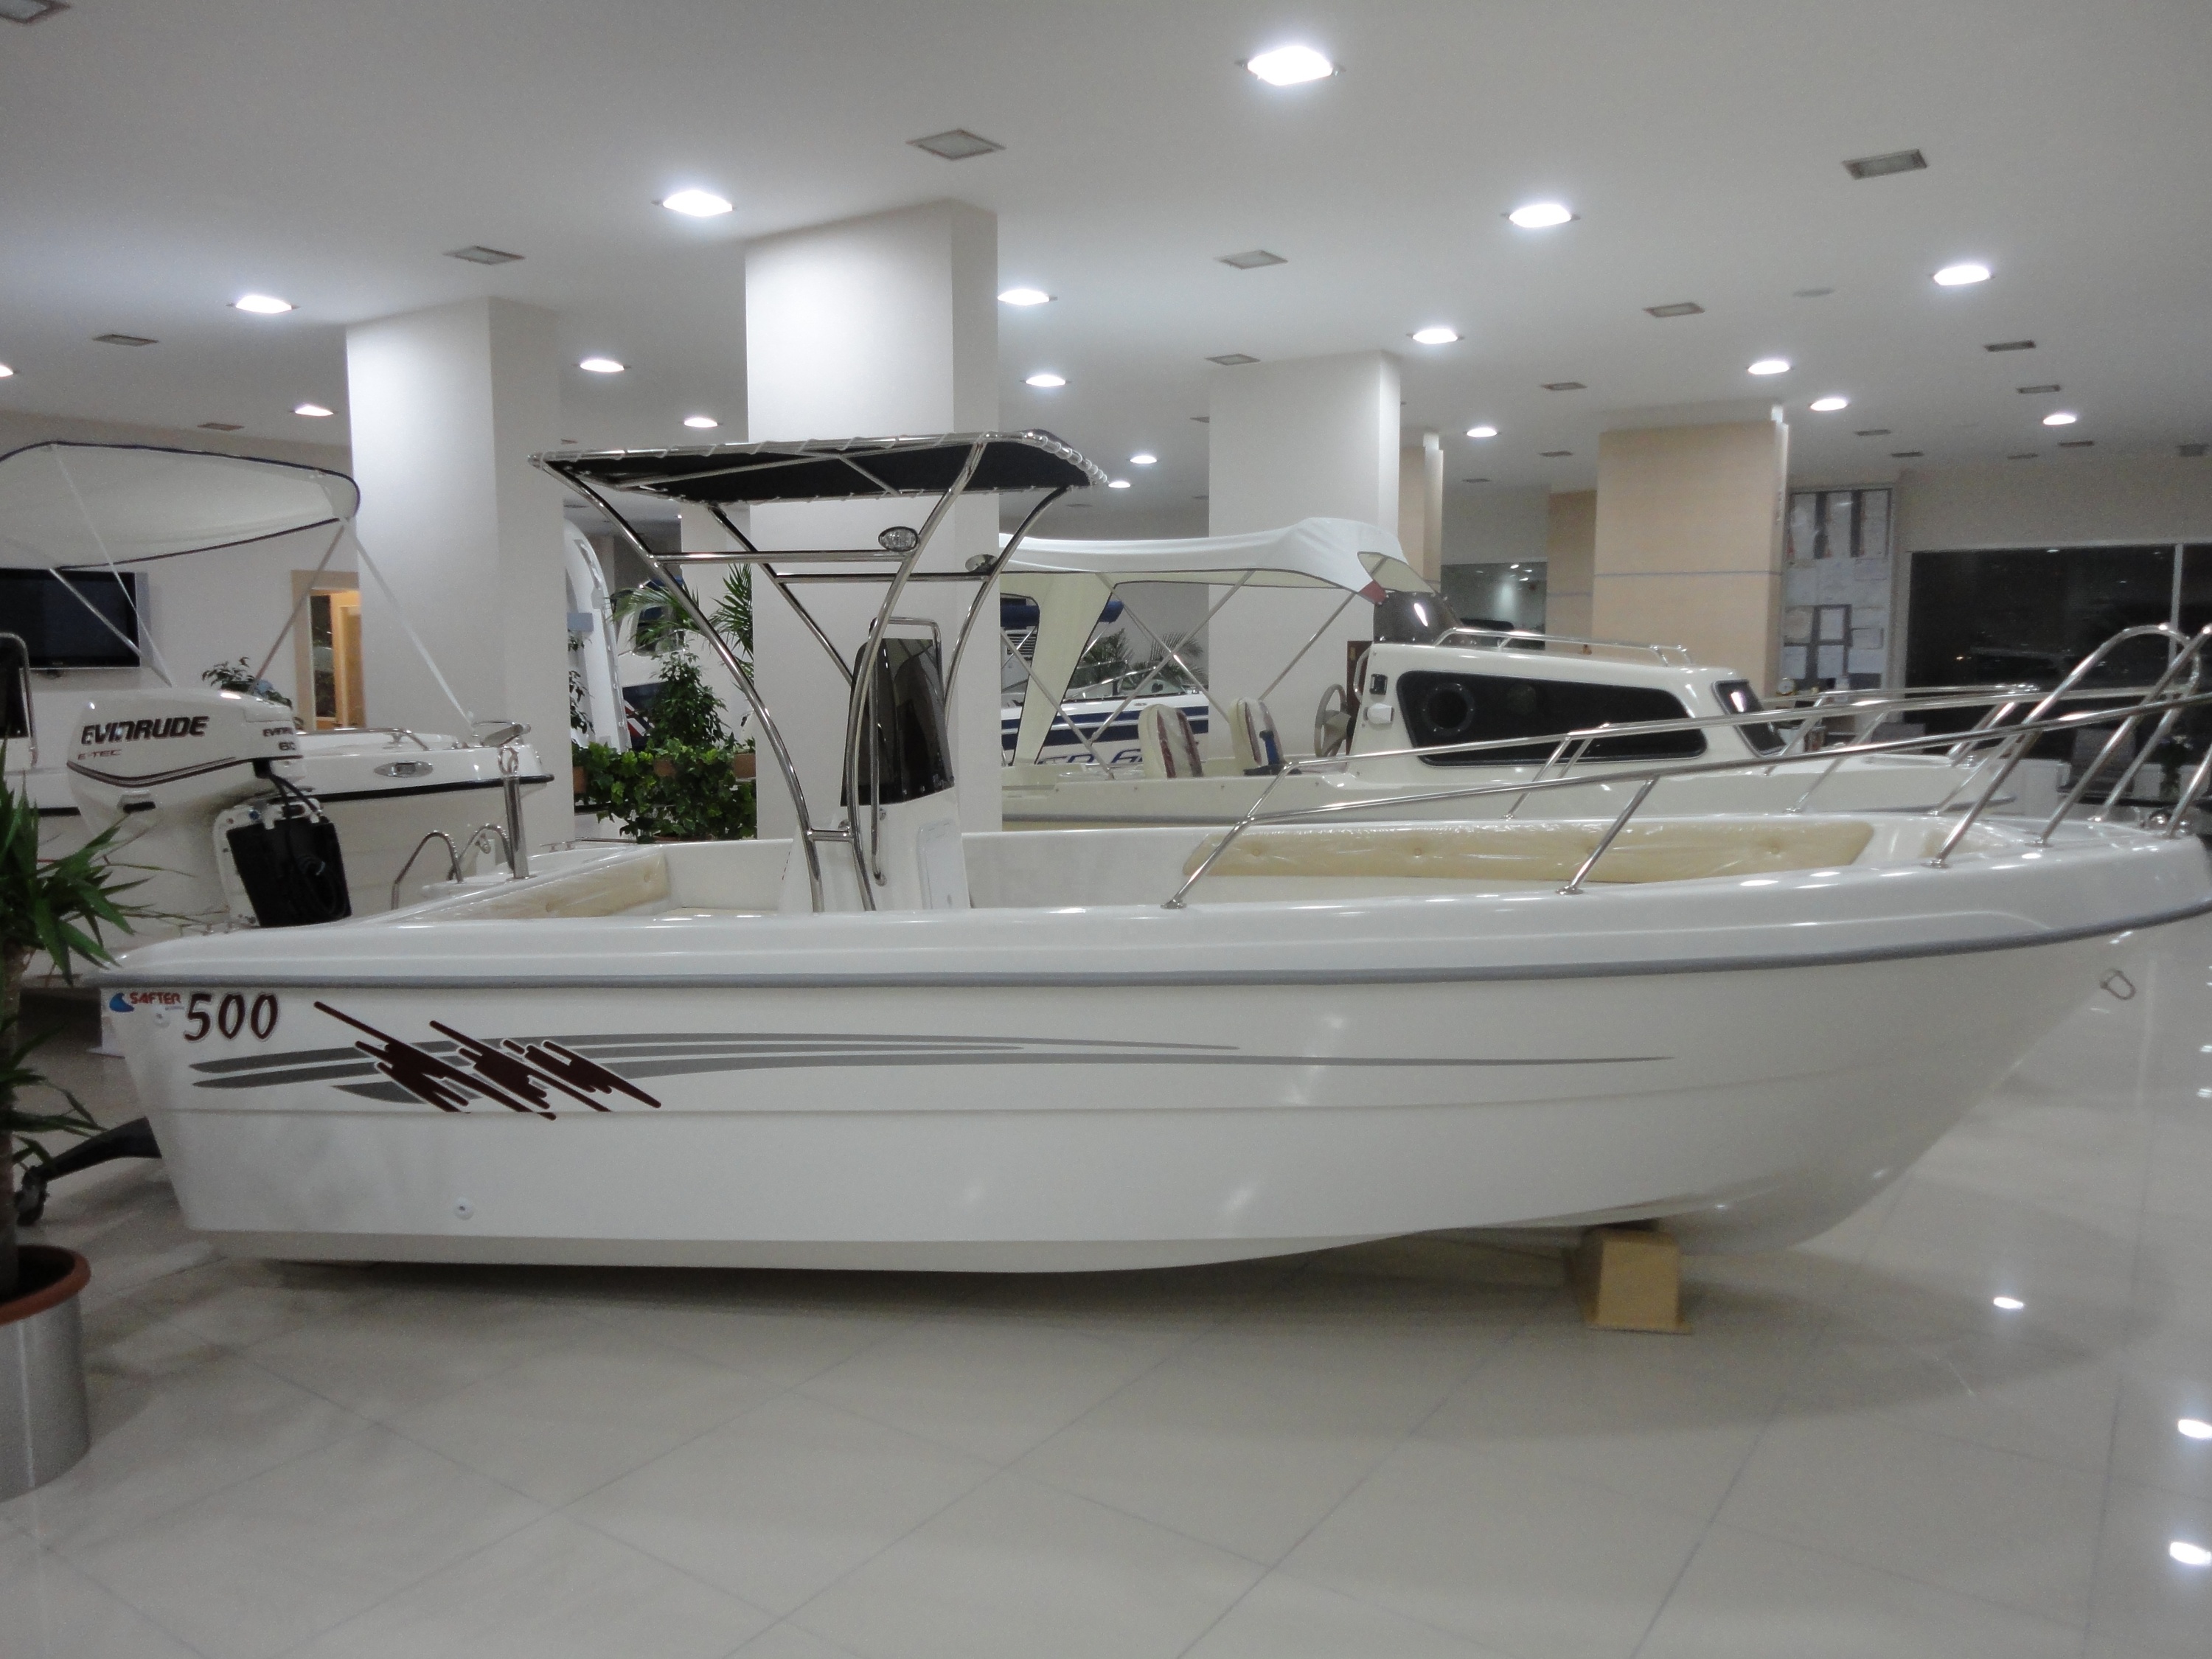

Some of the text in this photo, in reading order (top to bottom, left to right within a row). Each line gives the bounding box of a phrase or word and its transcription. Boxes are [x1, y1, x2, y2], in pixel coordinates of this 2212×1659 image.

[81, 716, 209, 745] EVINRUDE
[129, 992, 279, 1041] SAFTER 500
